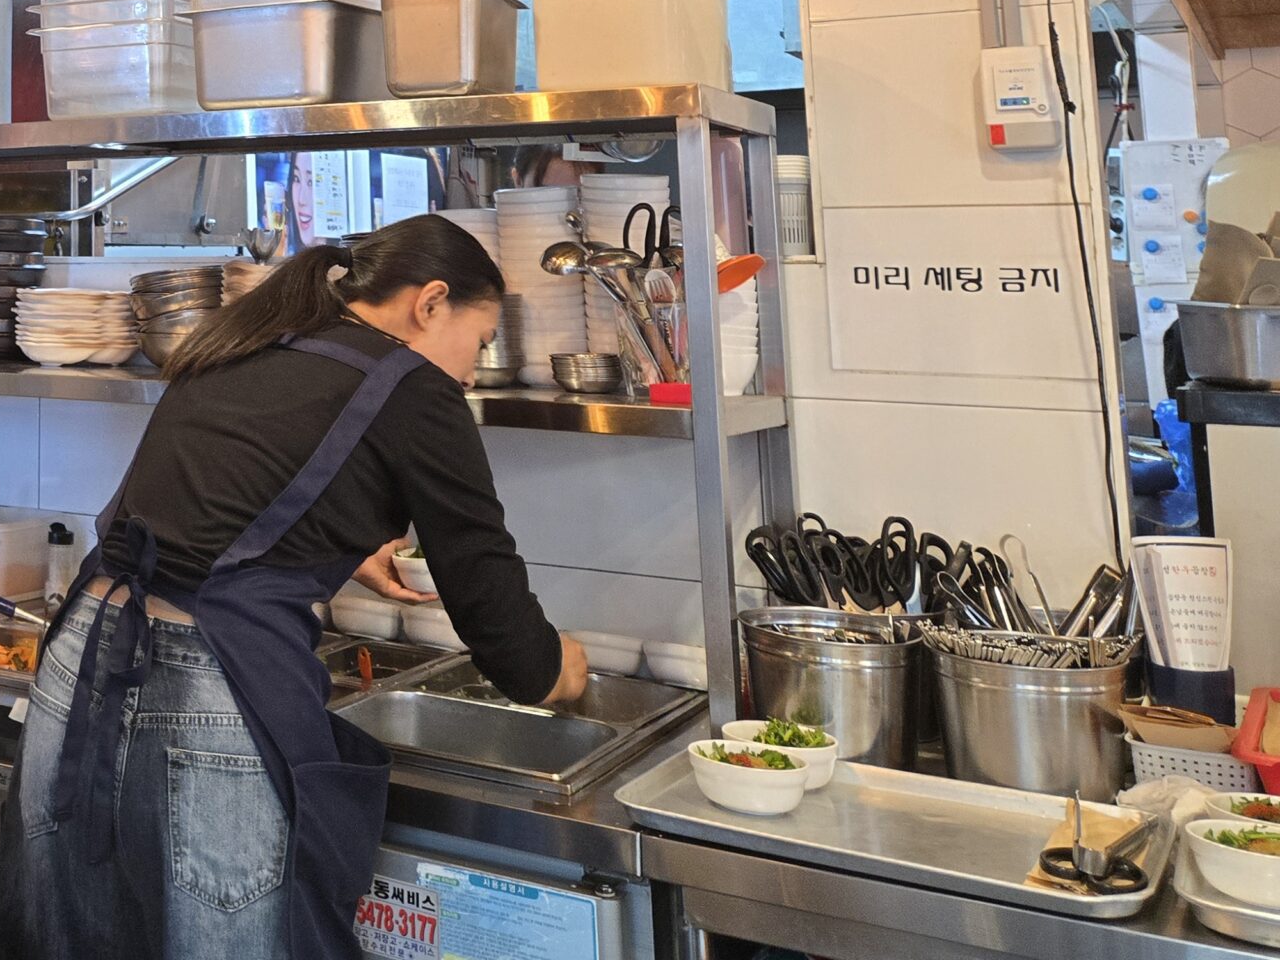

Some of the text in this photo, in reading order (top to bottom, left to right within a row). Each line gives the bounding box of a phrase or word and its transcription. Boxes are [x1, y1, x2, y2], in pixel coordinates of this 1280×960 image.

[853, 266, 1060, 293] 미리 세팅 금지
[368, 879, 436, 913] 동써비스
